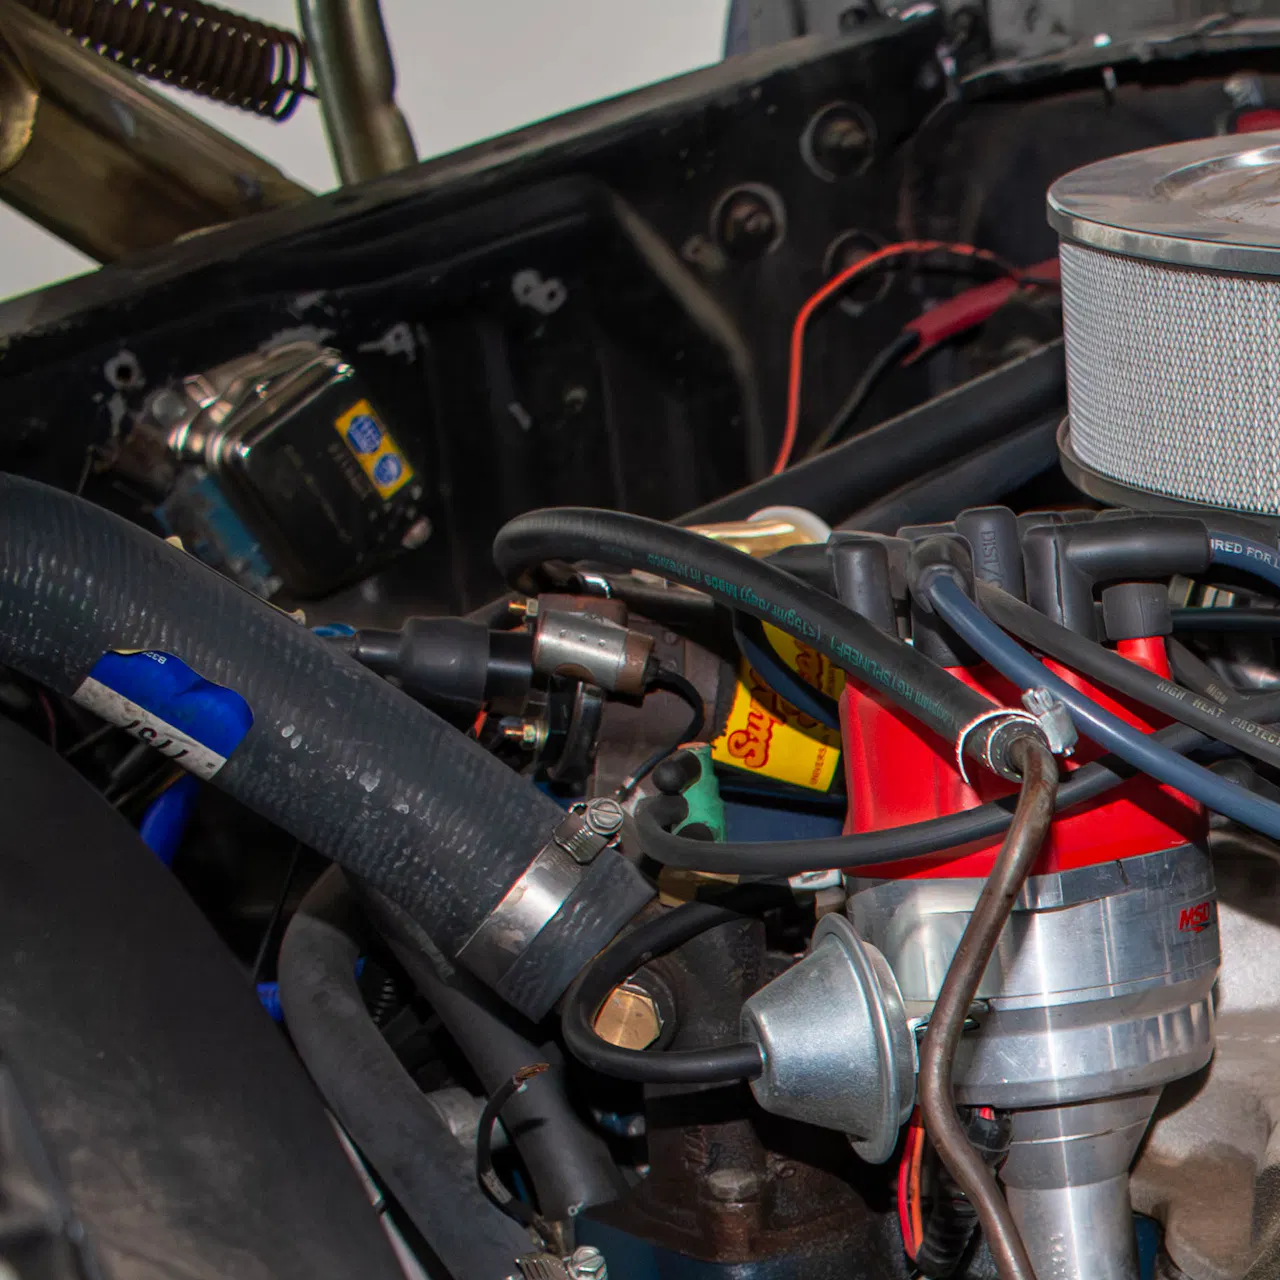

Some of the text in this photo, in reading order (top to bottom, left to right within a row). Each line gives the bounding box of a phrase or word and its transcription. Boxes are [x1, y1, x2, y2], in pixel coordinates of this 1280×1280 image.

[1210, 538, 1243, 554] IRED
[1246, 546, 1272, 564] FOR
[1156, 680, 1186, 701] HIGH
[1192, 699, 1225, 719] HEAT
[1178, 900, 1211, 932] MSD
